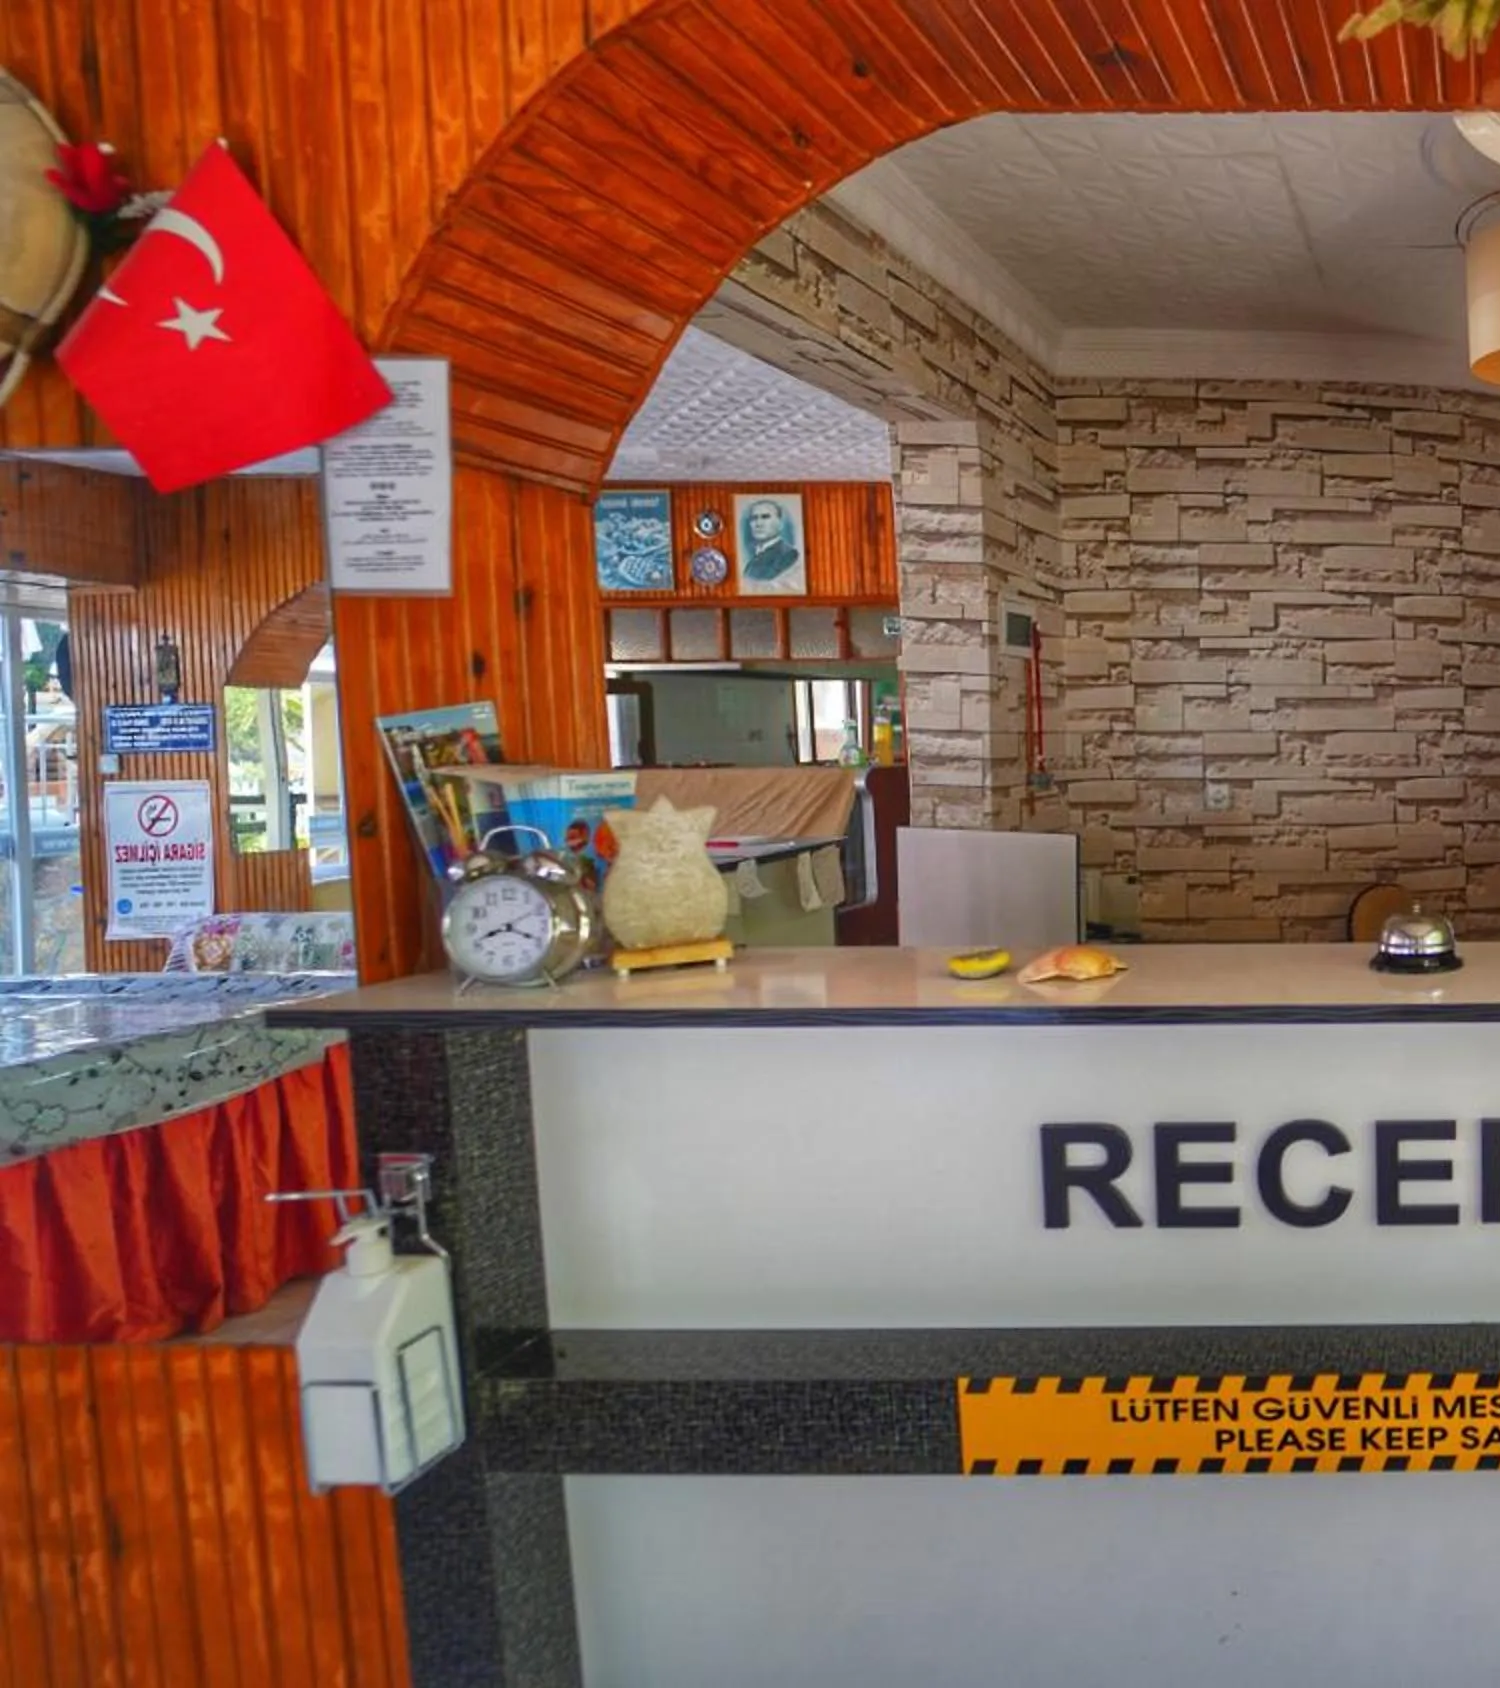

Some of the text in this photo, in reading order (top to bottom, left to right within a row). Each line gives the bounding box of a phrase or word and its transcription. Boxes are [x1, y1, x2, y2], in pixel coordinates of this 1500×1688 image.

[1110, 1398, 1240, 1423] LÜTFEN
[1215, 1427, 1346, 1453] PLEASE
[1360, 1425, 1448, 1451] KEEP
